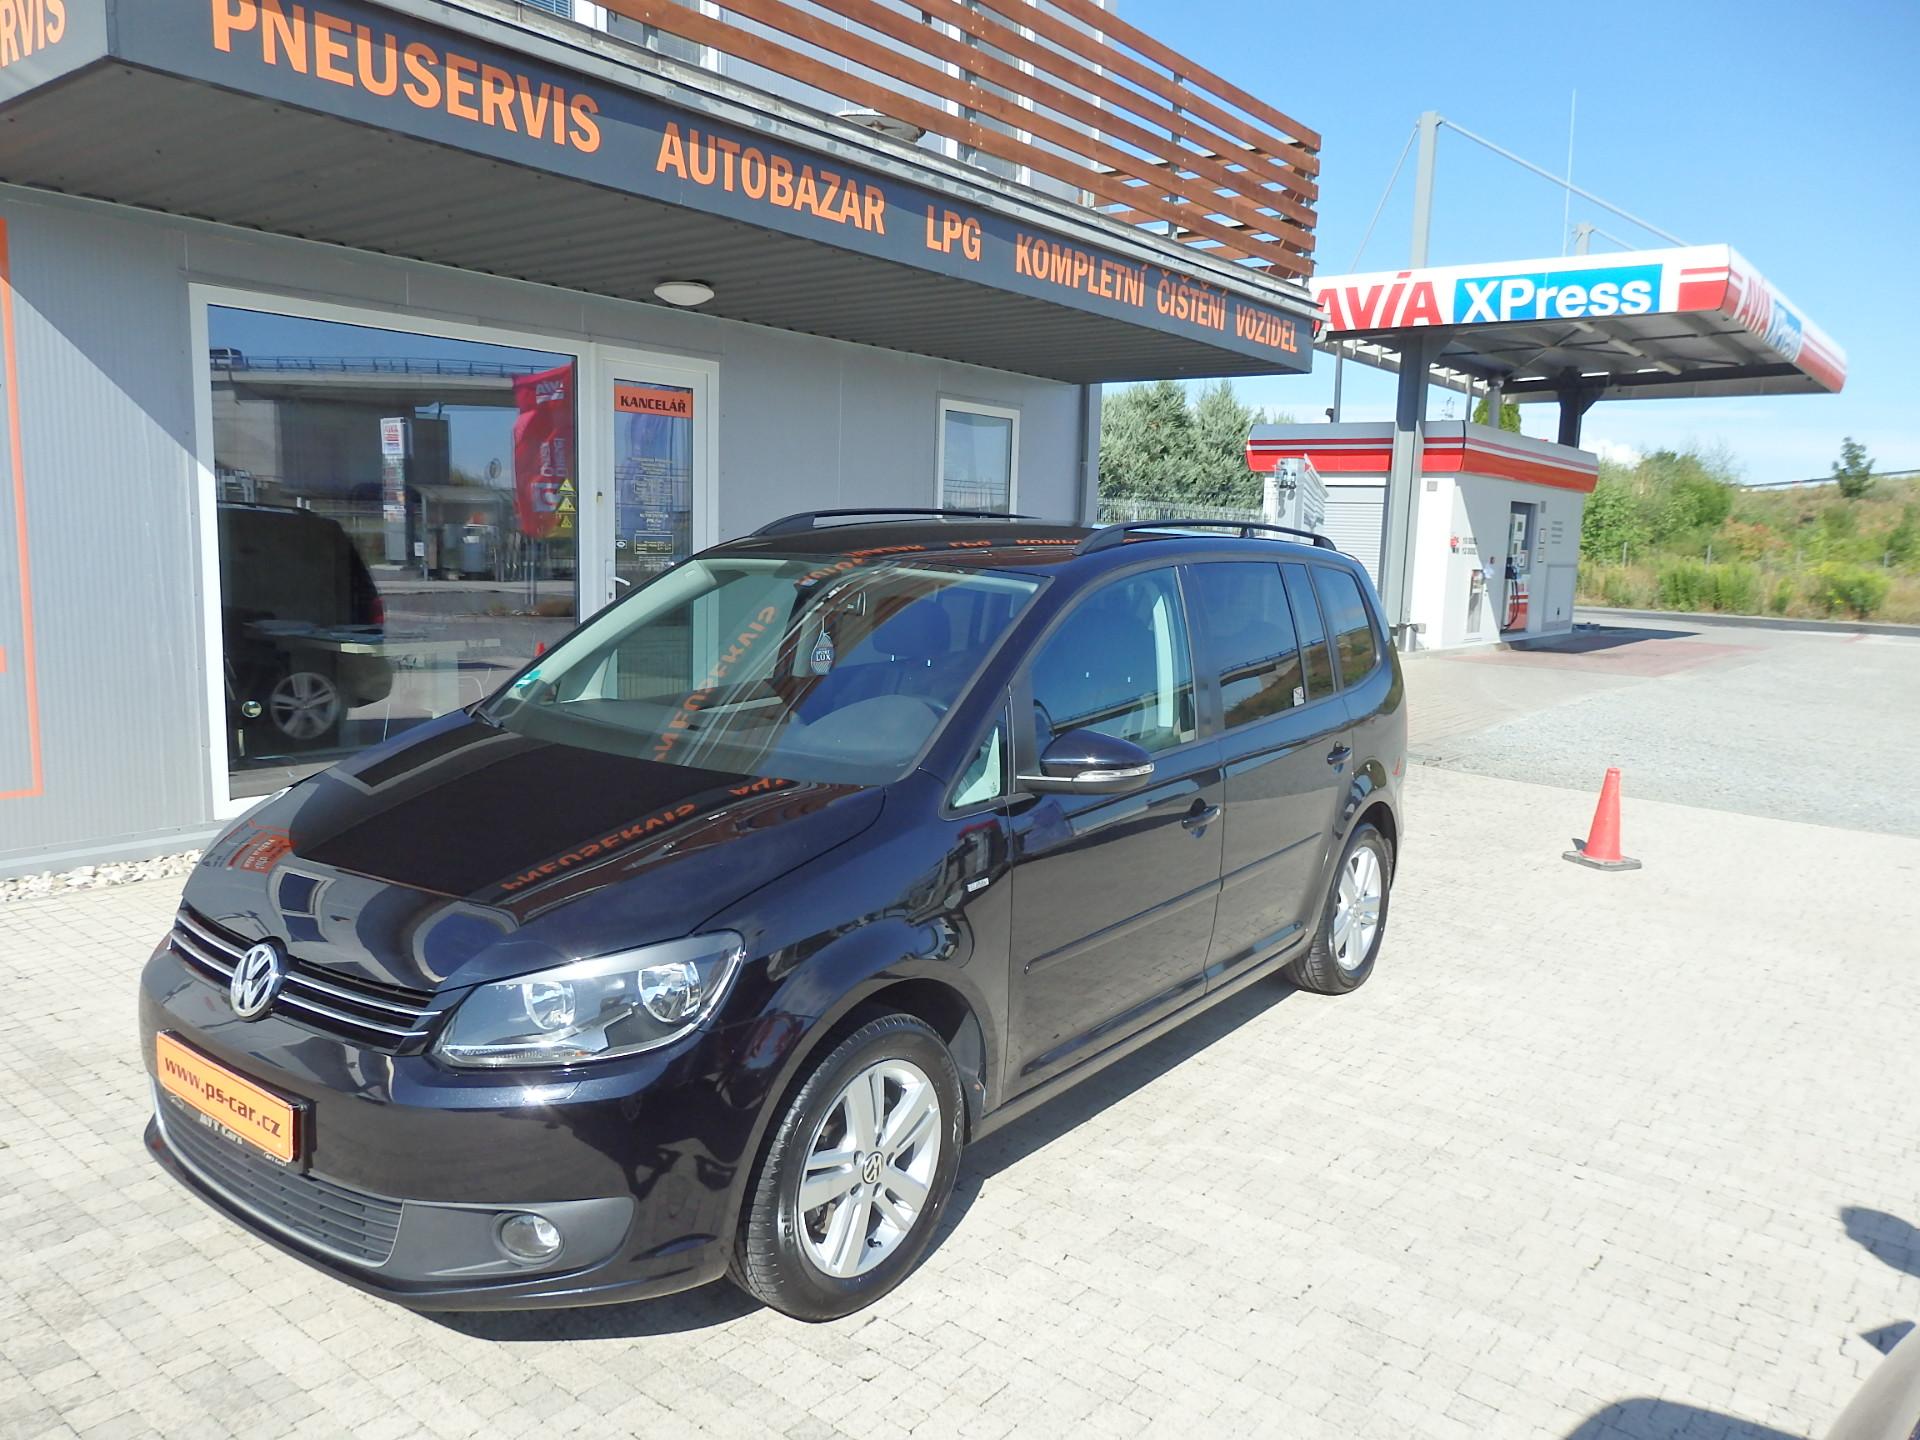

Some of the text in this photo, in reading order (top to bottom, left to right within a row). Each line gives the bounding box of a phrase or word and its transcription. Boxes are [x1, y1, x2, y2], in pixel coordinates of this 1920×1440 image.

[212, 0, 602, 153] PNEUSERVIS
[656, 122, 886, 235] AUTOBAZAR
[925, 205, 982, 261] LPG
[1015, 233, 1298, 353] KOMPLETNÍ ČIŠTĚNÍ VOZIDEL
[1461, 278, 1653, 324] XPress
[620, 395, 687, 413] KANCELÁŘ
[164, 1057, 281, 1138] www.ps-car.cz
